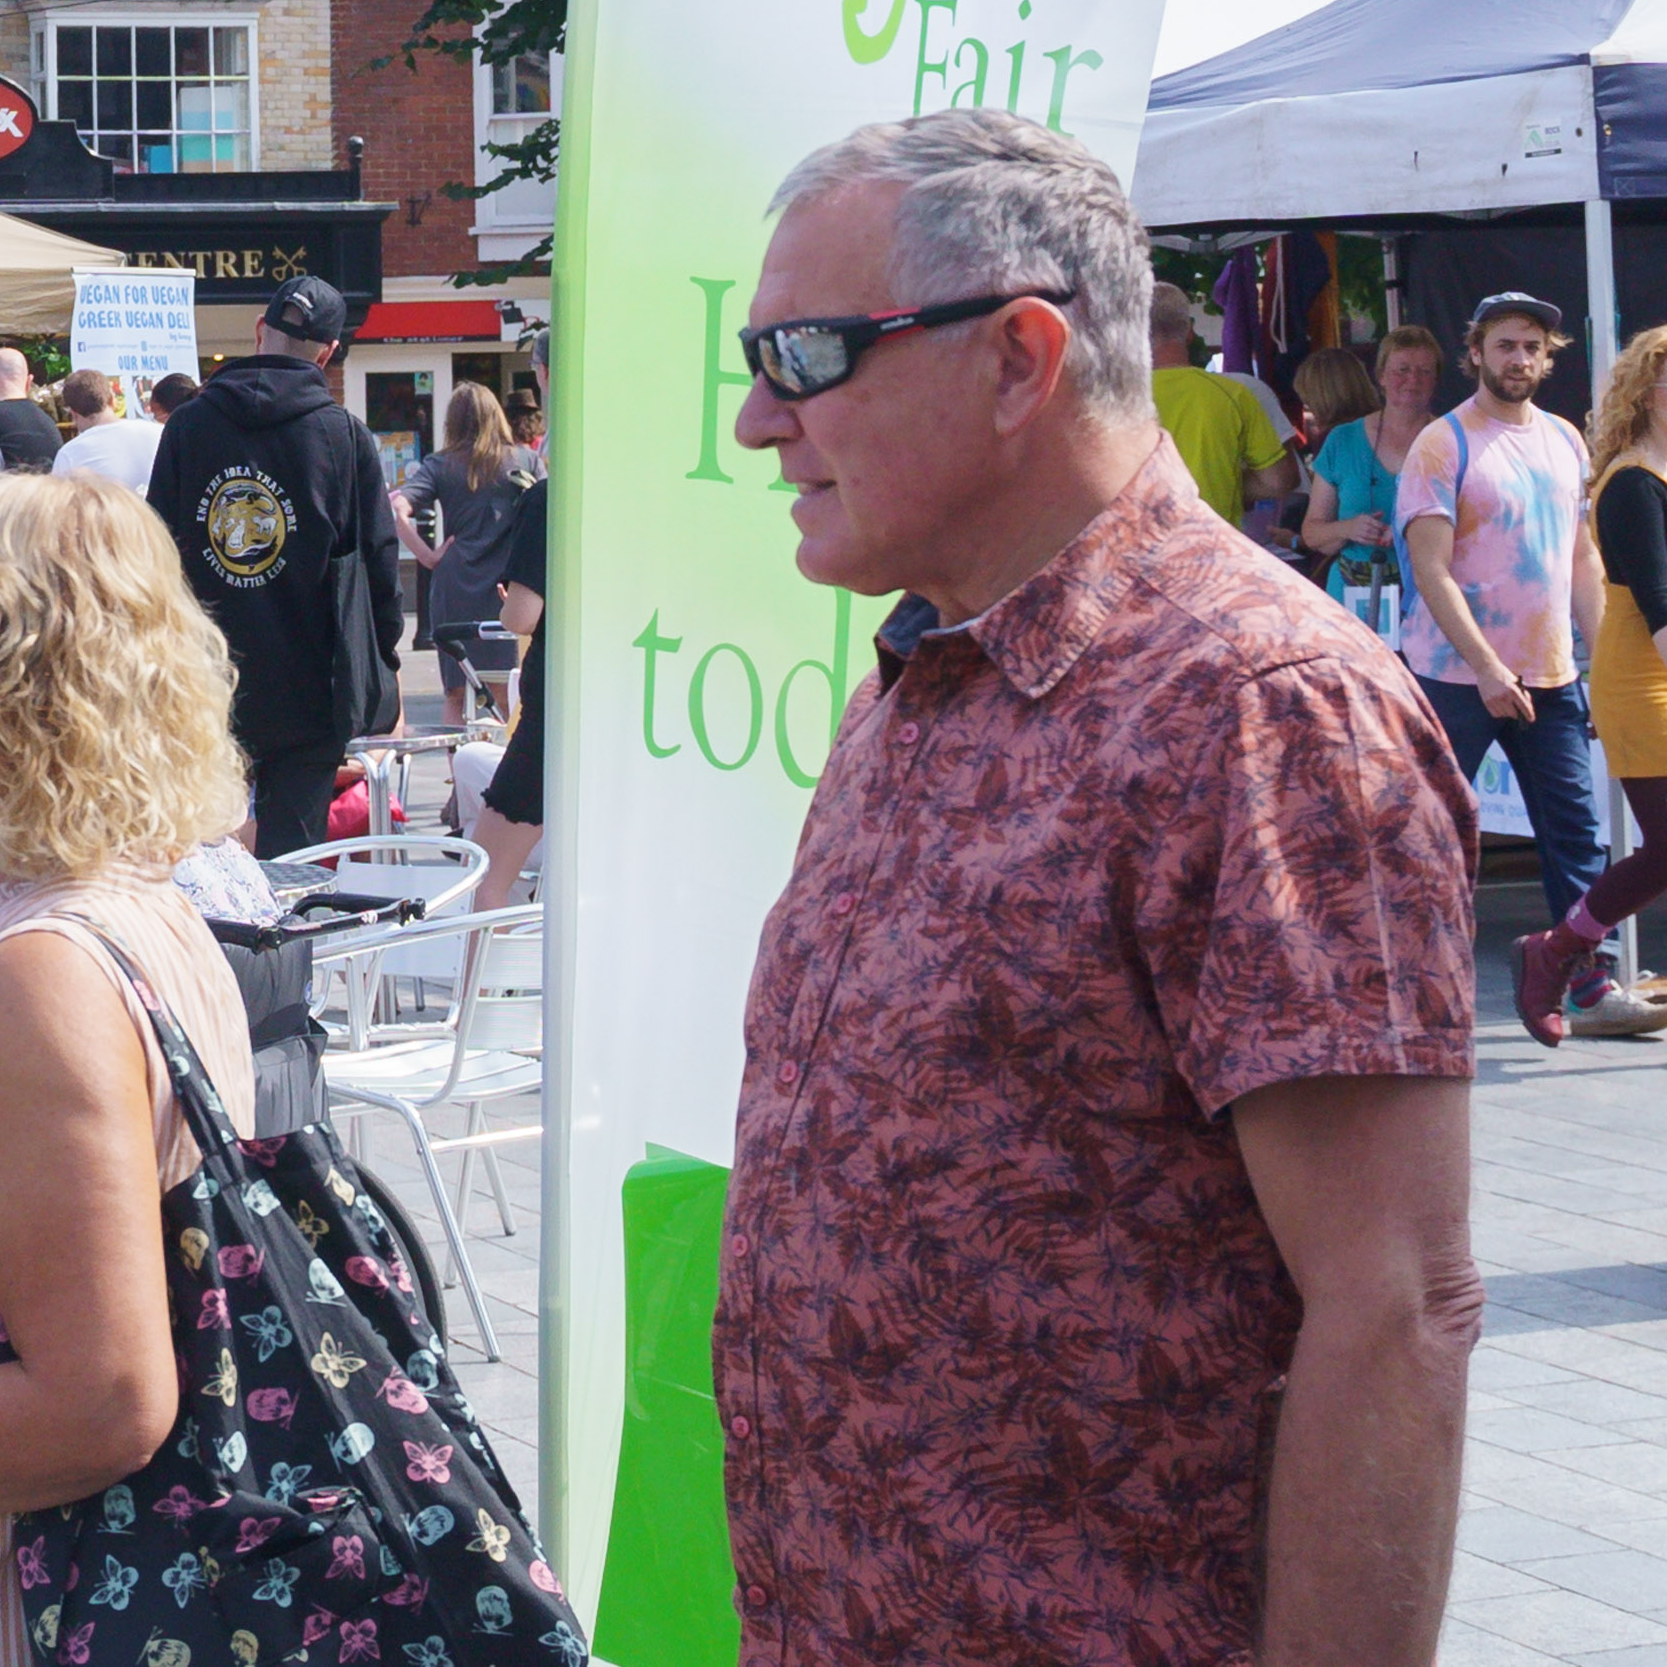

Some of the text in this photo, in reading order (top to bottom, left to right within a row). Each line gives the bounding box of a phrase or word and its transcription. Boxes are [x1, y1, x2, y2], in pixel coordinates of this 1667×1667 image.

[126, 250, 265, 279] ENTRE
[79, 284, 190, 306] VEGAN FOR VEGAN
[78, 310, 190, 330] GREEK VEGAN DELI
[117, 355, 169, 371] OUR MENU
